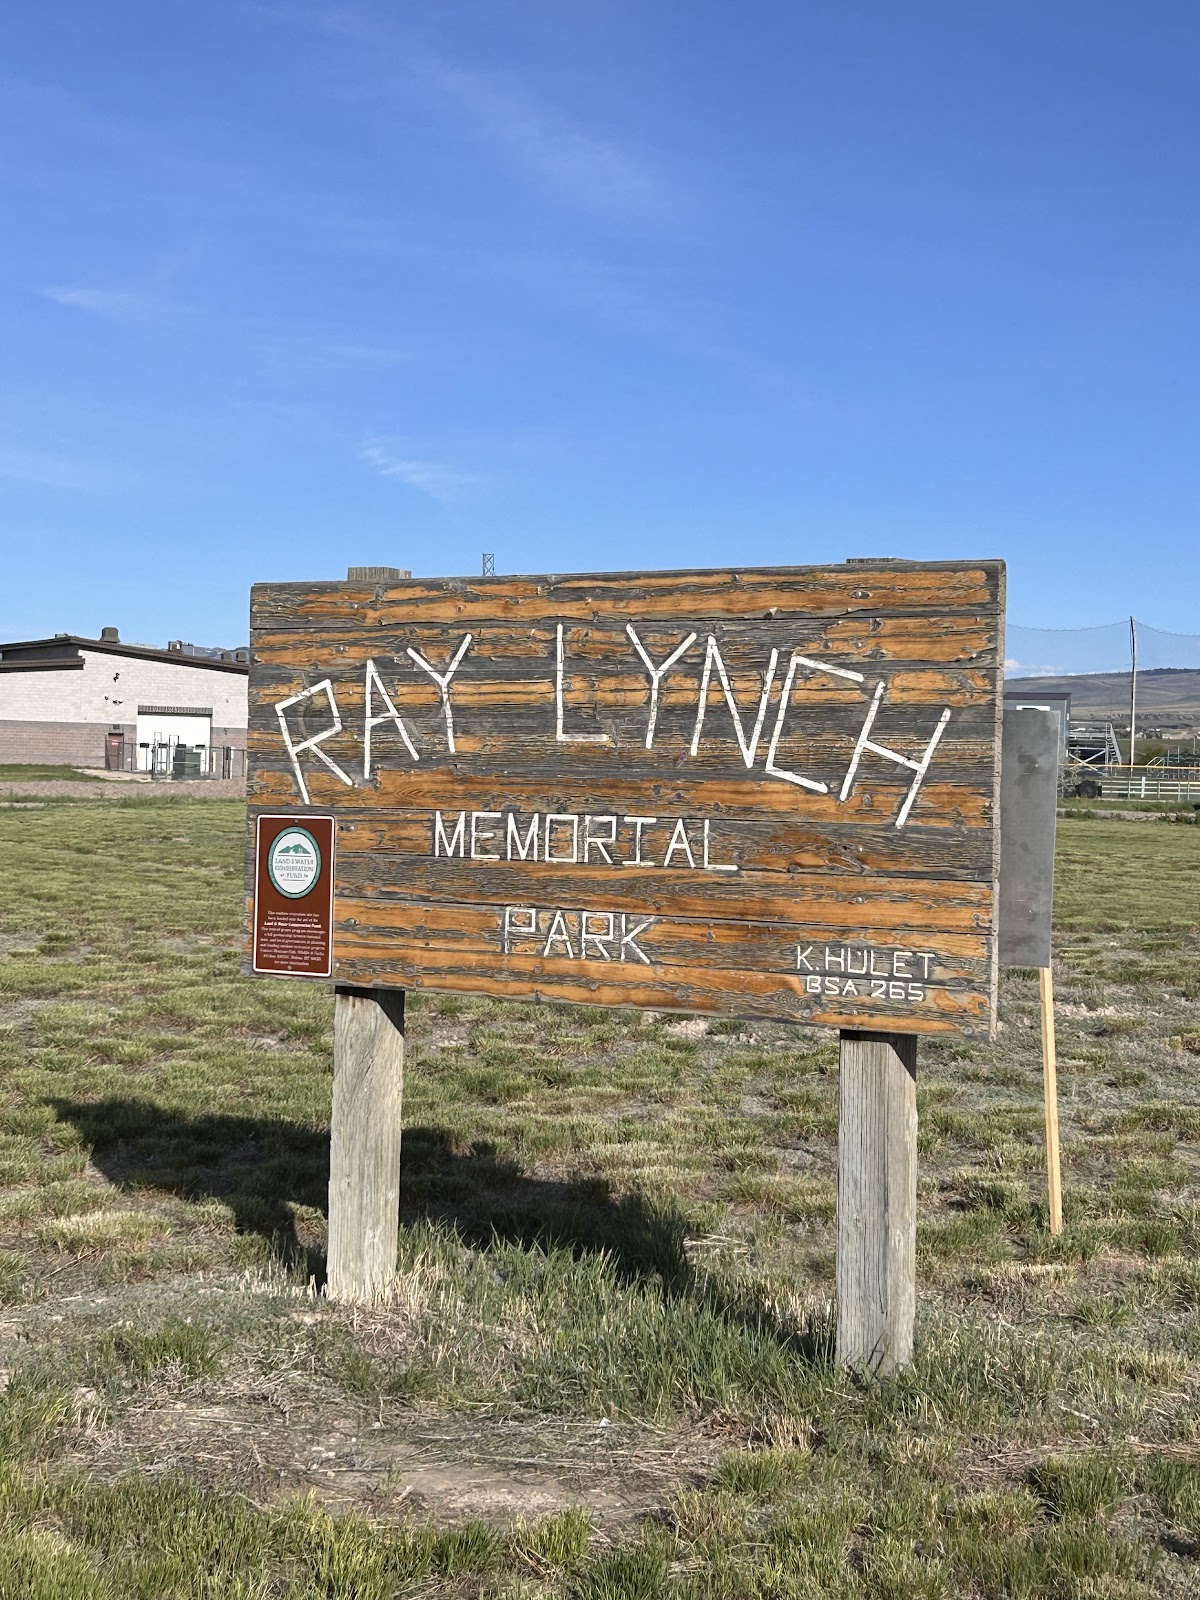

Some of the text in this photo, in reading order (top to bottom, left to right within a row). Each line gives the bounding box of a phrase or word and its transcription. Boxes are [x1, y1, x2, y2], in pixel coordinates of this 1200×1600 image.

[275, 622, 952, 829] RAY LYNCH
[435, 811, 738, 870] MEMORIAL
[504, 907, 656, 964] PARK
[806, 975, 925, 1001] BSA 265
